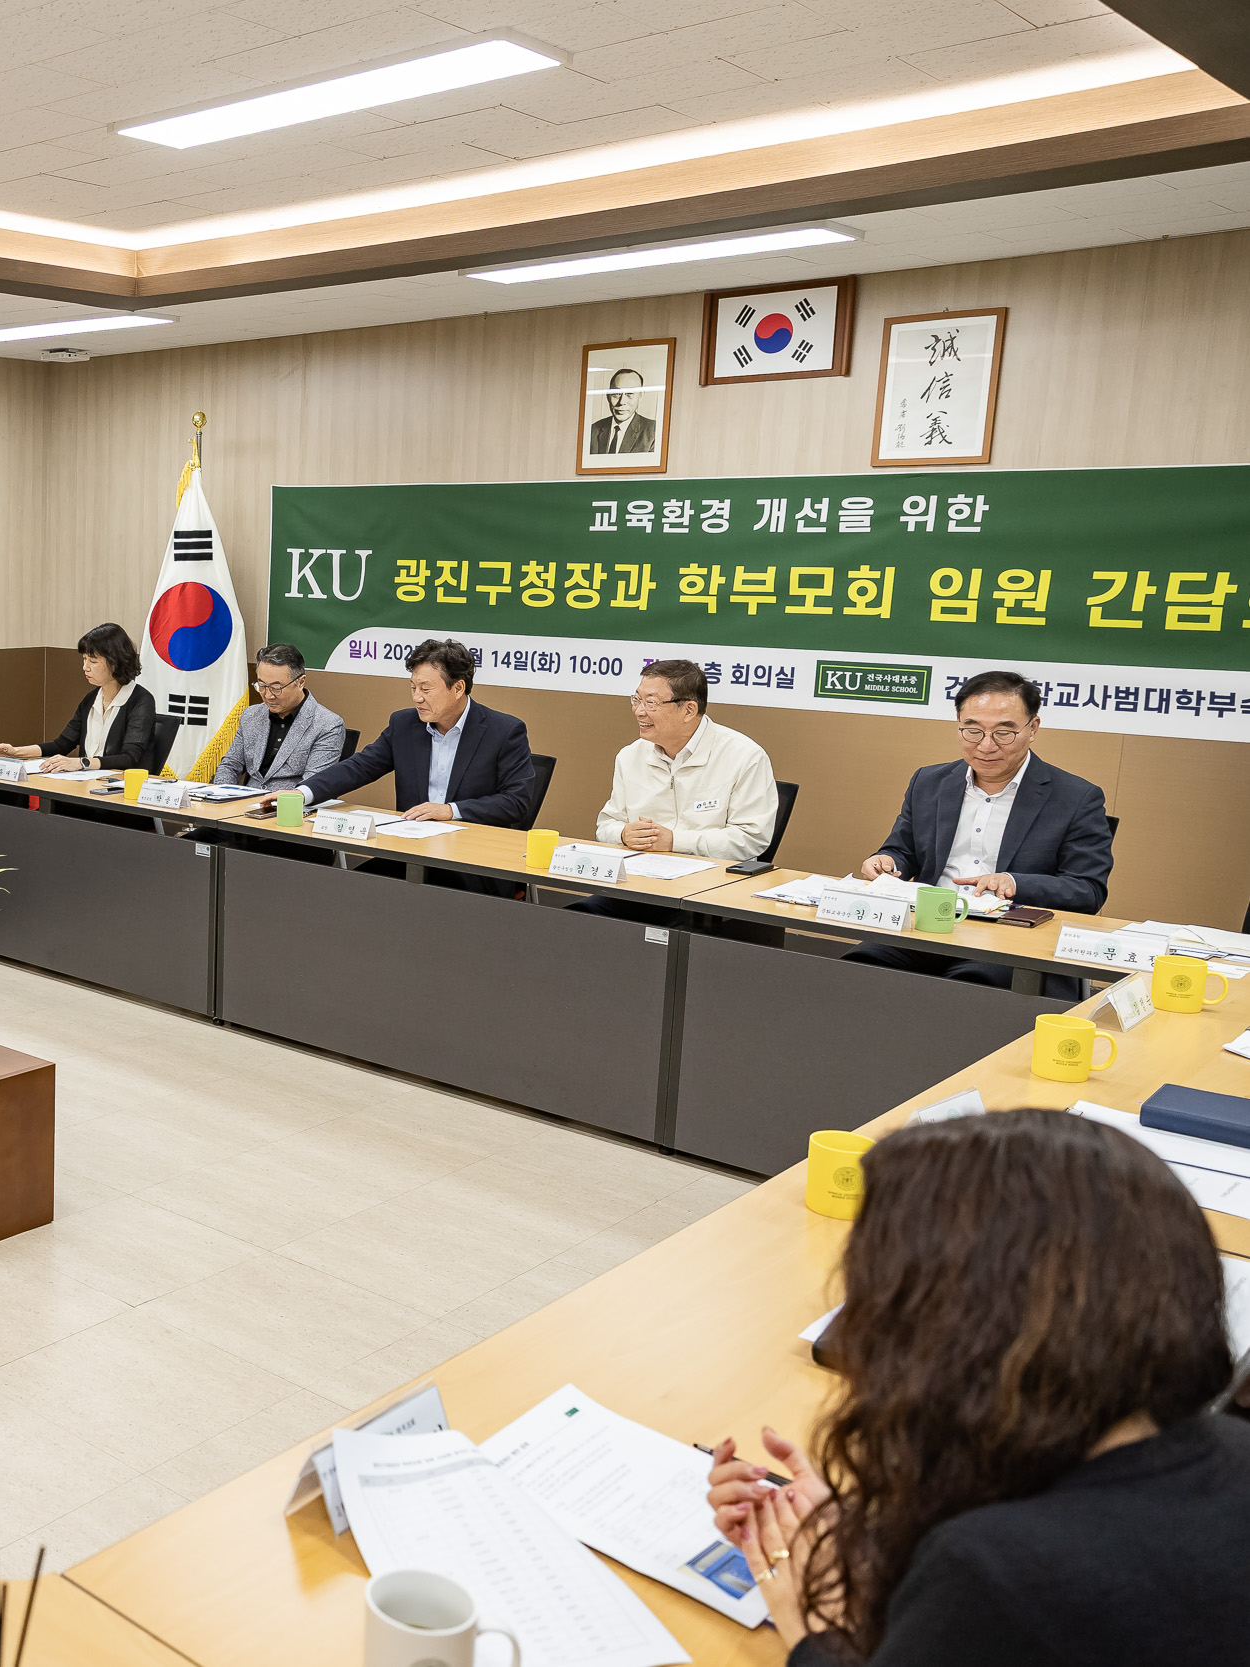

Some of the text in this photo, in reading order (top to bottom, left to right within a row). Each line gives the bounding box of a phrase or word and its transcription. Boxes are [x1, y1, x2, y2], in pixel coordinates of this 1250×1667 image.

[589, 494, 990, 534] 교육환경 개선을 위한
[284, 548, 373, 601] KU
[394, 559, 1250, 632] 광진구청장과 학부모회 임원 간담
[349, 639, 377, 660] 일시
[383, 643, 419, 661] 202
[491, 650, 561, 674] 14일(화)
[569, 655, 623, 677] 10:00
[730, 662, 796, 689] 회의실
[825, 670, 863, 691] KU
[864, 684, 918, 694] MIDDLE SCHOOL
